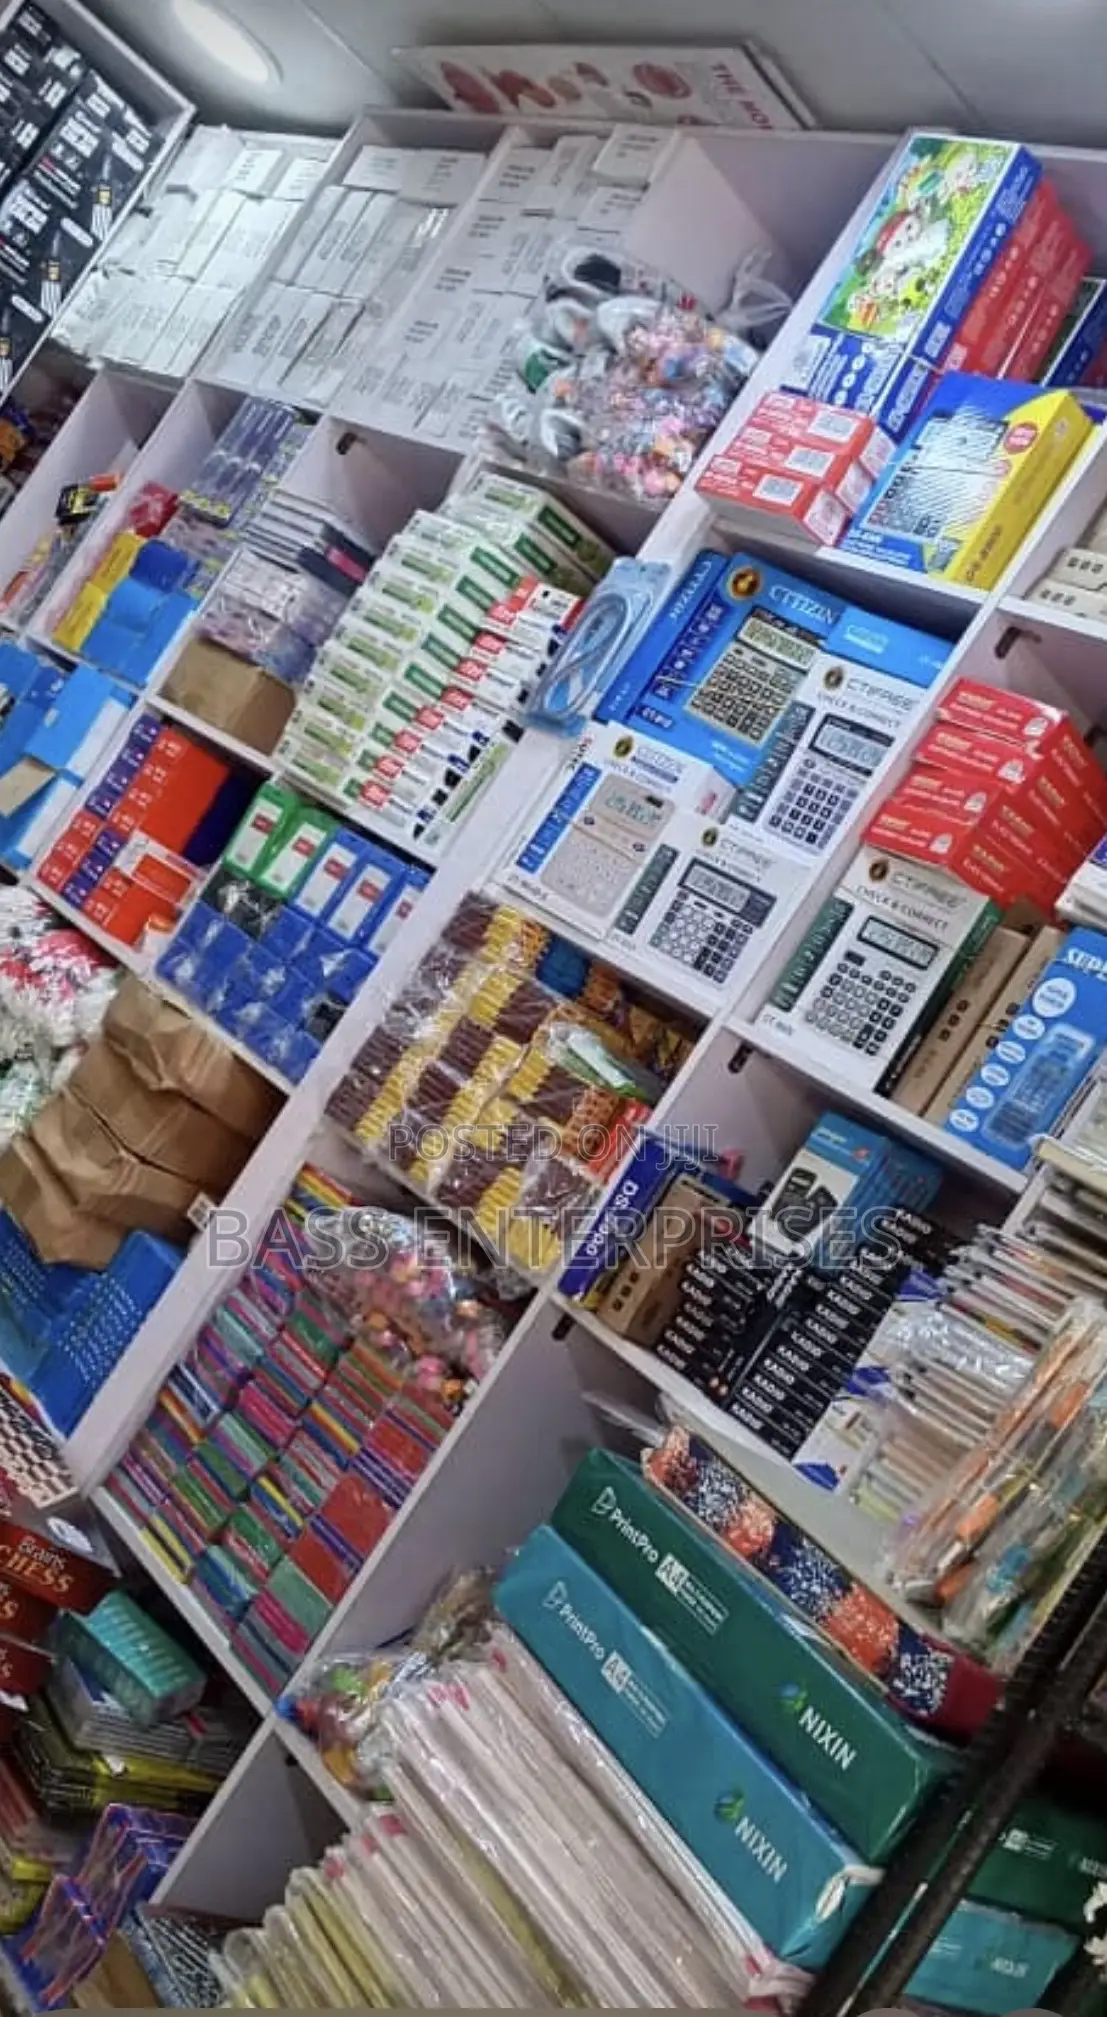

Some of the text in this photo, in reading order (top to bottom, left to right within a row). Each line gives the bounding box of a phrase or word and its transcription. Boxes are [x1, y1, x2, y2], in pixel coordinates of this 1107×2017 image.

[608, 1507, 659, 1563] PrintPro
[559, 1603, 605, 1660] PrintPro
[799, 1704, 857, 1771] NIXIN
[735, 1815, 788, 1885] NIXIN
